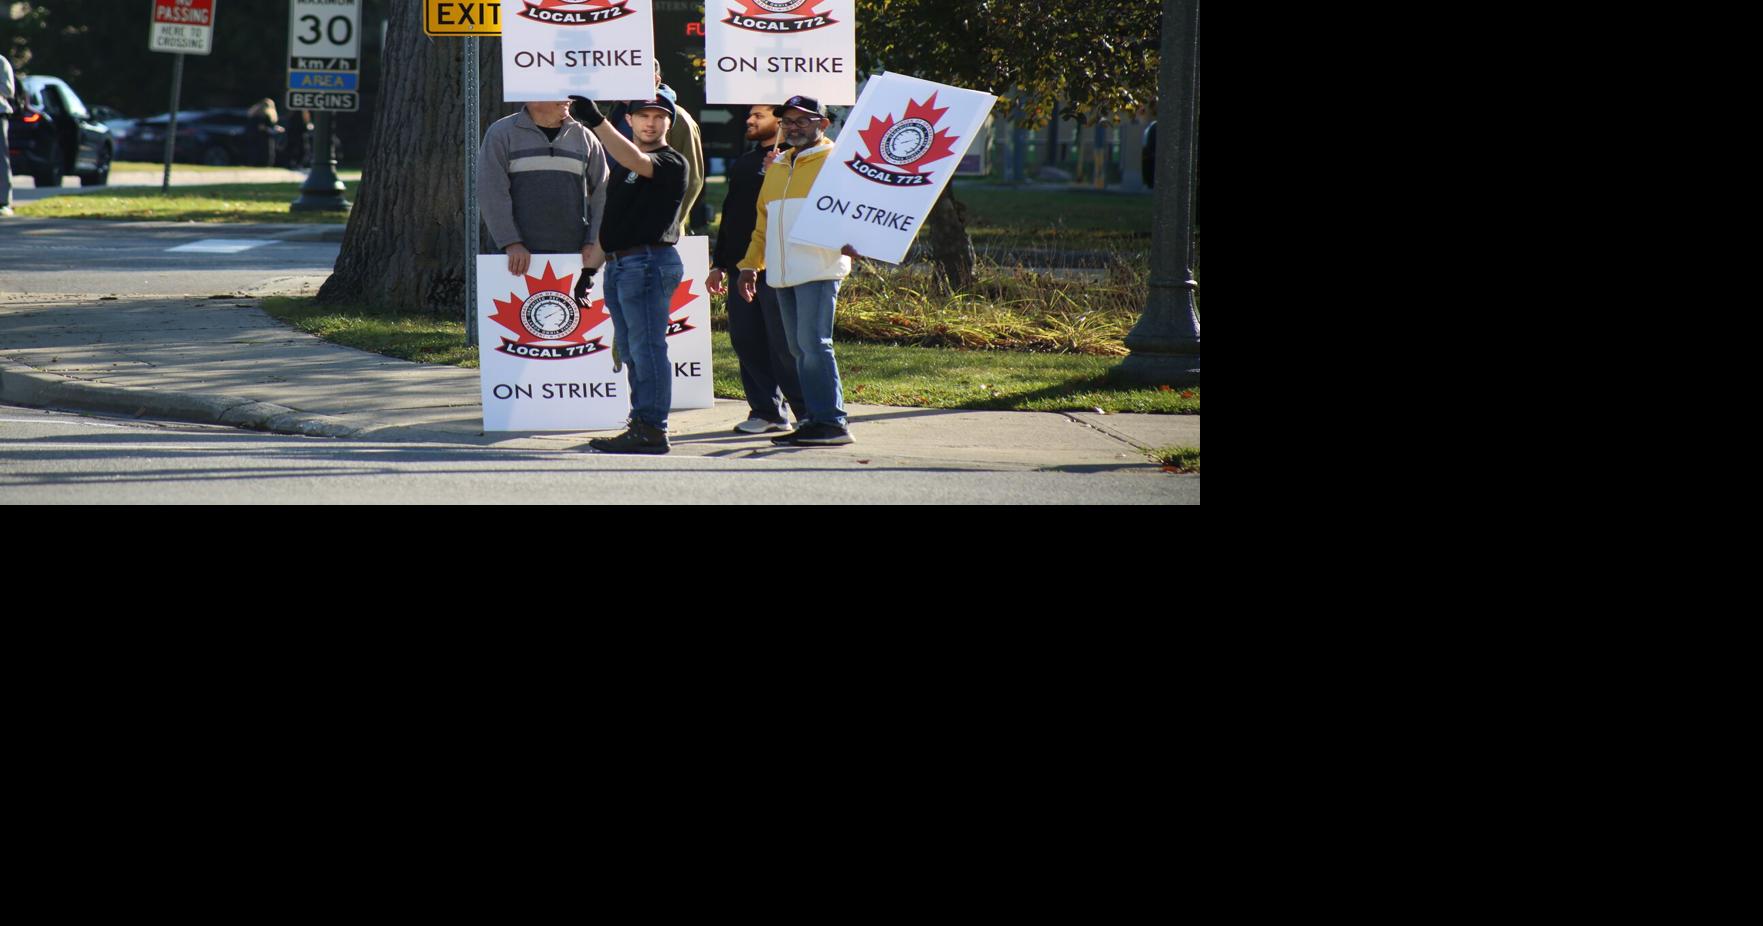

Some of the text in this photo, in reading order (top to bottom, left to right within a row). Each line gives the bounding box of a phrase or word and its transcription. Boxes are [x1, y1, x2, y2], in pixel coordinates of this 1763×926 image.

[156, 7, 208, 23] PASSING
[438, 3, 501, 24] EXIT
[528, 6, 622, 23] LOCAL 772
[298, 14, 353, 45] 30
[733, 15, 825, 31] LOCAL 772
[158, 36, 204, 48] CROSSING
[298, 58, 350, 69] km/h
[514, 50, 642, 68] ON STRIKE
[717, 56, 843, 73] ON STRIKE
[302, 75, 344, 87] AREA
[293, 94, 351, 108] BEGINS
[852, 160, 924, 184] LOCAL 772
[816, 195, 915, 232] ON STRIKE
[506, 342, 596, 357] LOCAL 772
[493, 383, 617, 400] ON STRIKE
